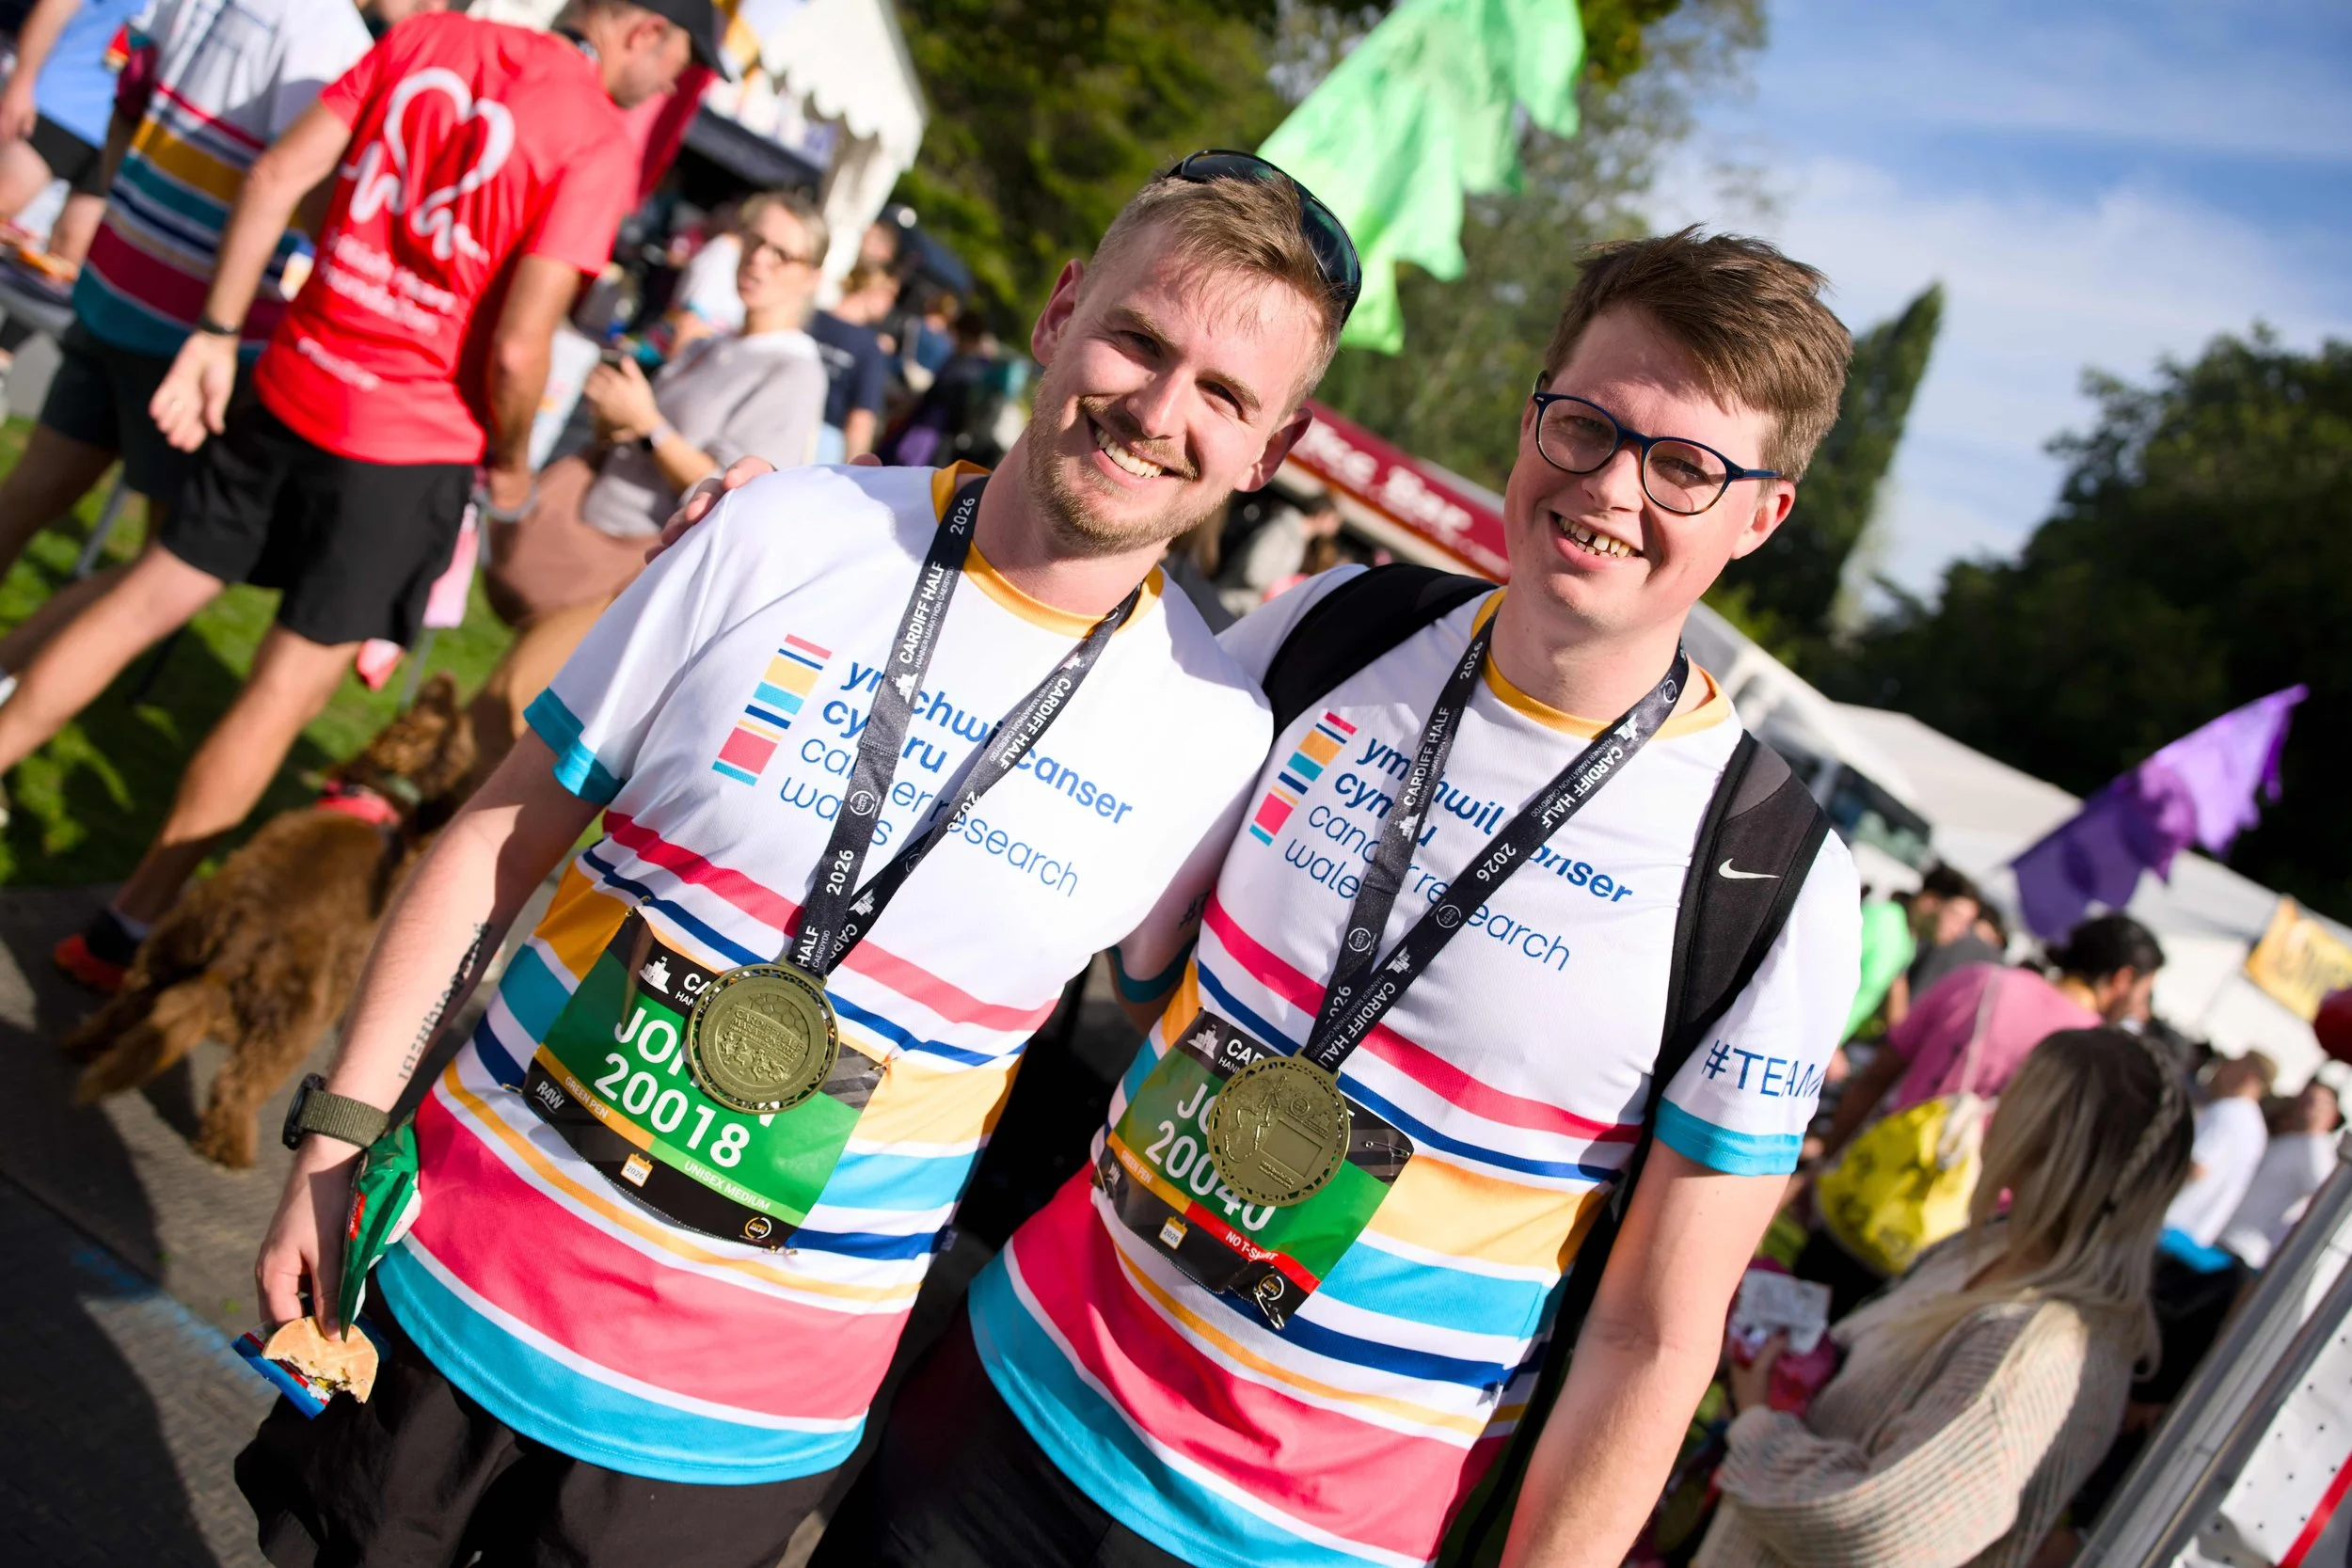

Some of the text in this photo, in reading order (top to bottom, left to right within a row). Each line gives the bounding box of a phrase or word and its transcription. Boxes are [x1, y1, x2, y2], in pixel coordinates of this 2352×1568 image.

[950, 497, 977, 536] 2026
[899, 562, 944, 663] CARDIFF HALF
[914, 640, 929, 668] HANNER
[924, 601, 943, 639] MARATHON
[1459, 641, 1484, 680] 2026
[840, 662, 1004, 751] ychwi
[997, 675, 1071, 769] CARDIFF HALF
[1010, 698, 1040, 731] MARATHON
[822, 700, 947, 773] cyru
[989, 730, 1014, 761] CAERDYDD
[1403, 707, 1449, 806] CARDIFF HALF
[1429, 745, 1445, 776] MARATHON
[801, 738, 933, 813] caer
[1531, 738, 1613, 816] HANNER MARATHON CAERDYDD
[1542, 743, 1623, 829] CARDIFF HALF
[780, 777, 893, 846] was
[1334, 772, 1438, 847] cymu
[1356, 738, 1633, 903] ymhwil anser
[826, 850, 854, 895] 2026
[1284, 838, 1360, 899] wale
[1476, 843, 1517, 881] 2026
[1413, 873, 1570, 971] reearch
[796, 926, 819, 967] HALF
[813, 930, 831, 968] CAERDYDD
[1327, 986, 1351, 1023] 026
[1348, 982, 1395, 1037] CARDIFF
[1361, 974, 1385, 999] HANNER
[1333, 998, 1363, 1032] MARATHON
[535, 1080, 565, 1110] R4W
[565, 1076, 609, 1119] GREEN PEN
[594, 1053, 751, 1168] 20018
[625, 1164, 644, 1180] 2026
[684, 1160, 771, 1211] UNISEX MEDIUM
[1163, 1227, 1179, 1243] 2026
[1225, 1231, 1242, 1247] NO
